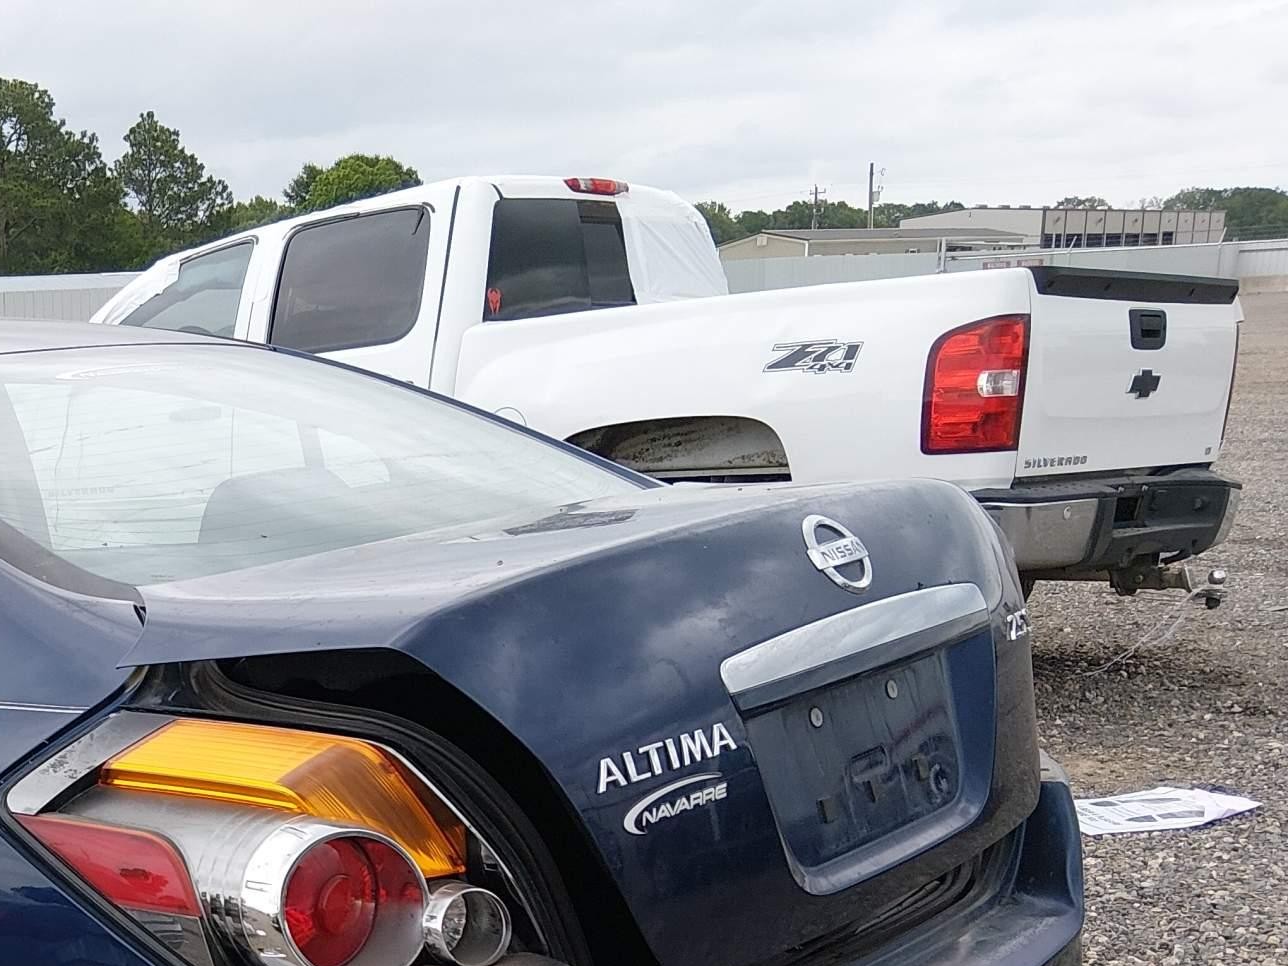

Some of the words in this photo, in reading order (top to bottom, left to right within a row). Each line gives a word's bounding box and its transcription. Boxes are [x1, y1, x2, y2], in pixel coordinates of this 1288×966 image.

[762, 339, 864, 372] Z71
[1023, 455, 1088, 469] SILVERADO
[596, 722, 738, 794] ALTIMA
[641, 782, 728, 827] NAVARRE
